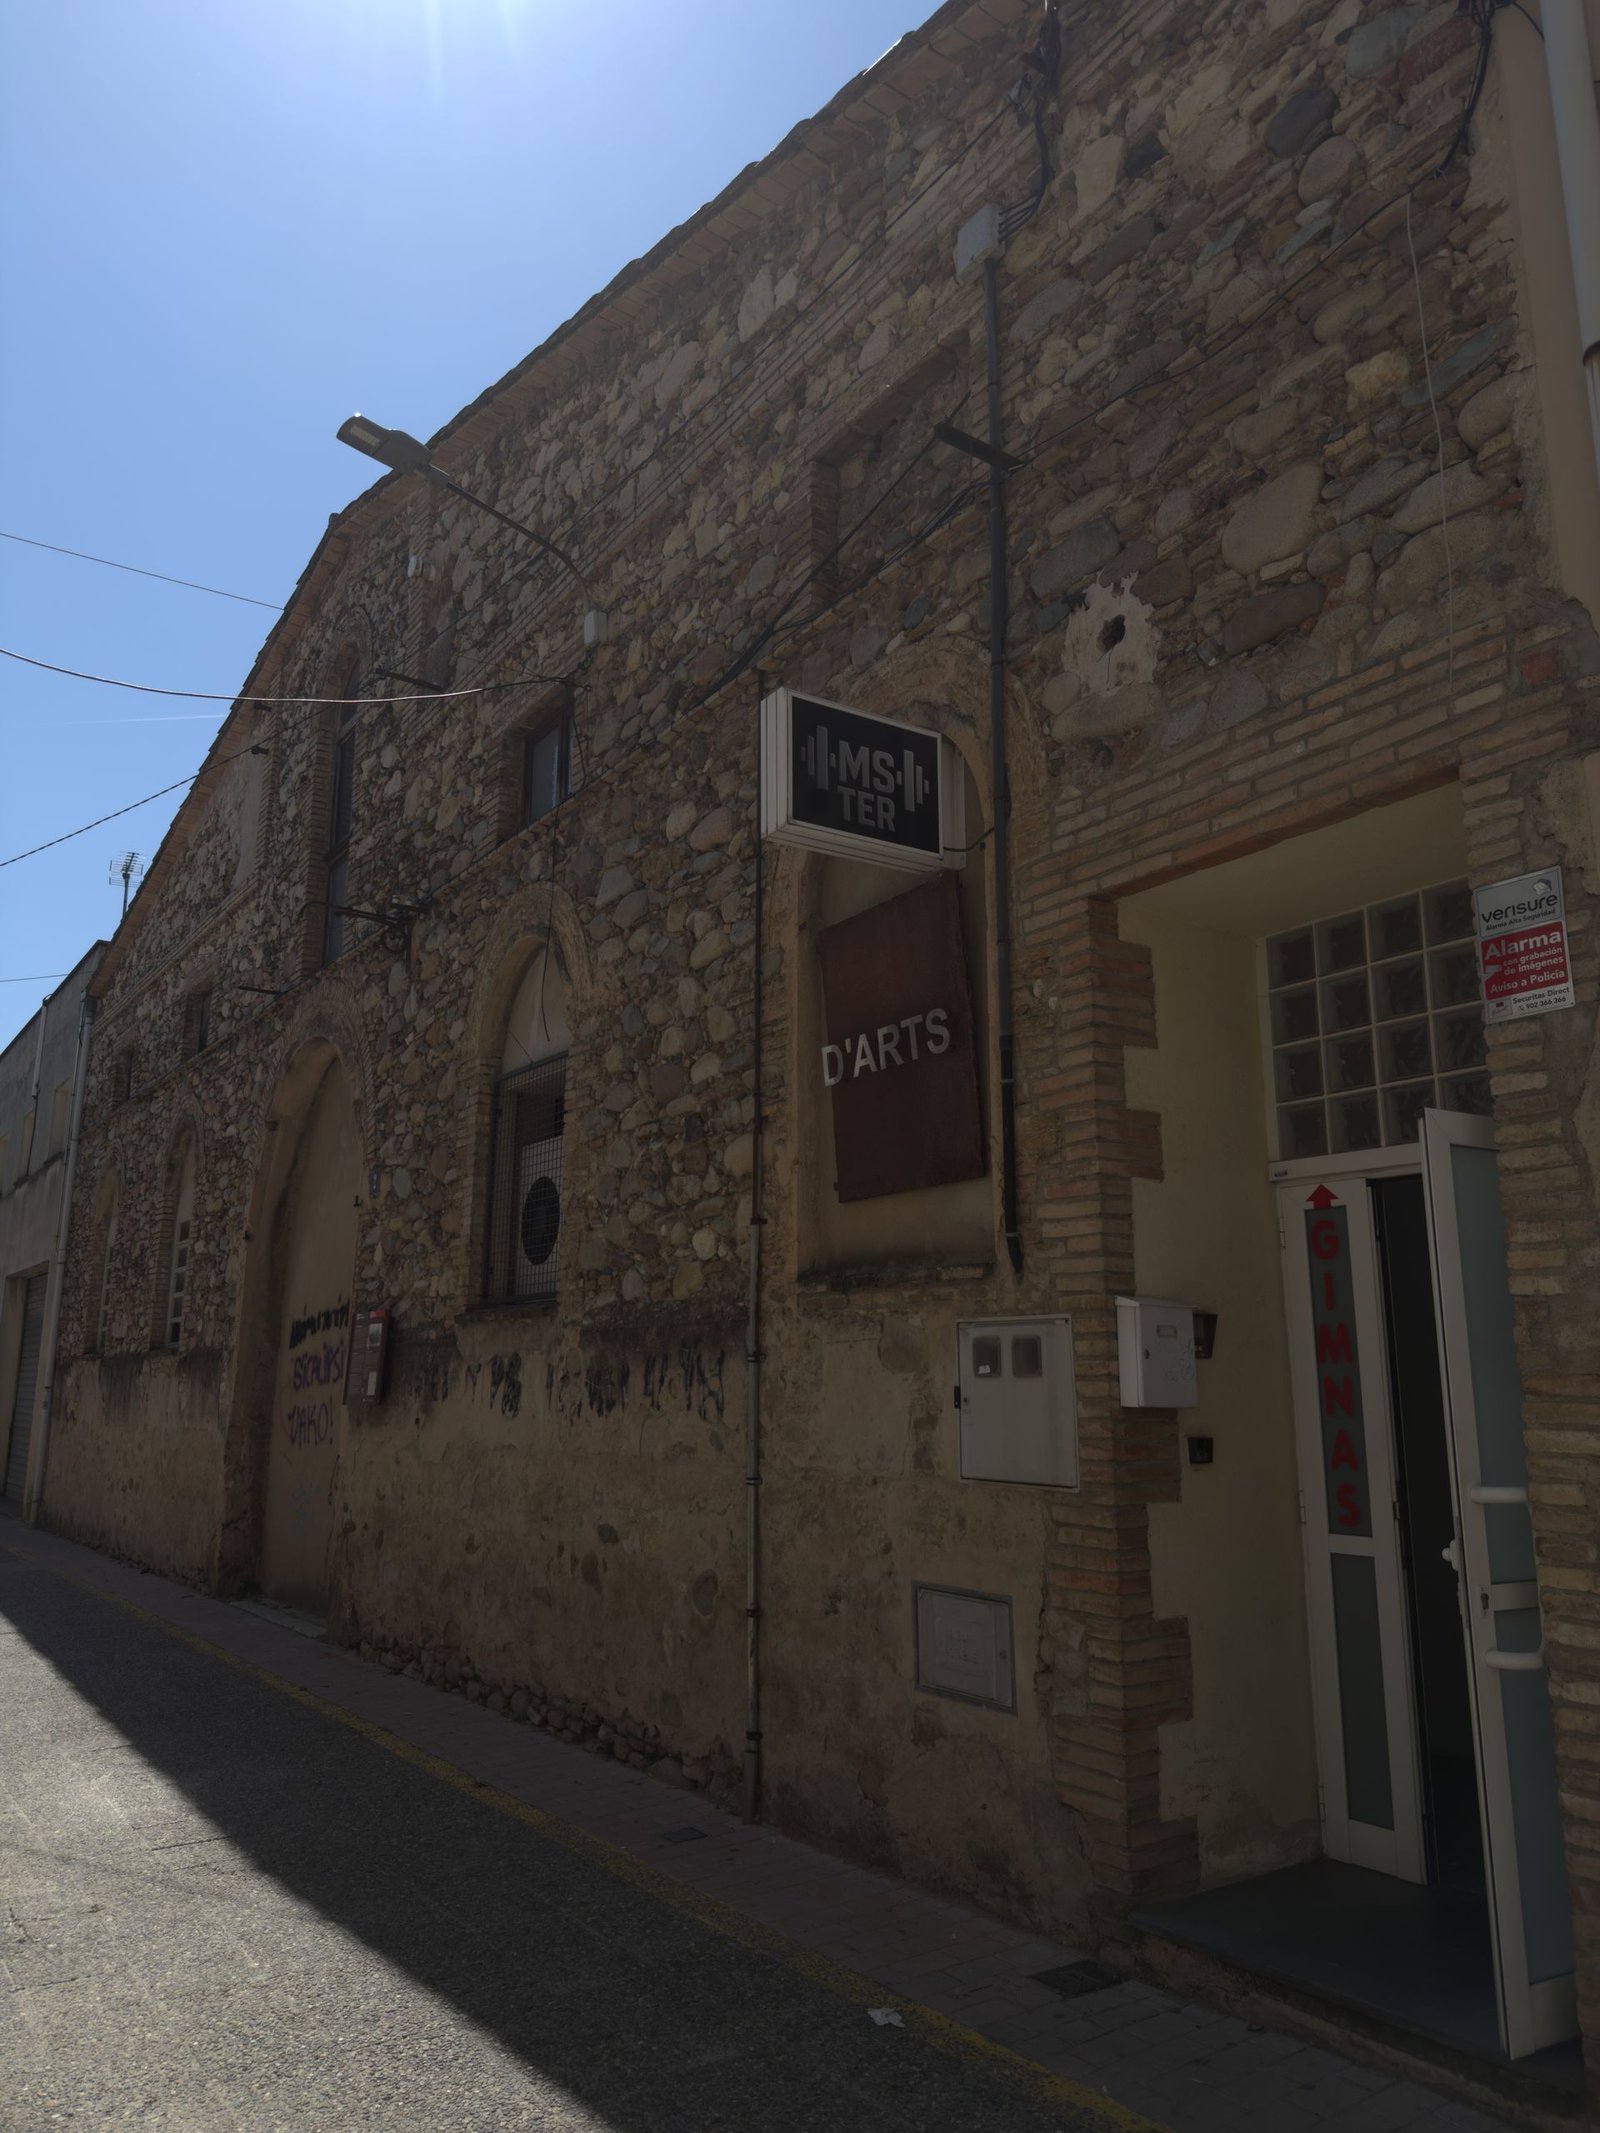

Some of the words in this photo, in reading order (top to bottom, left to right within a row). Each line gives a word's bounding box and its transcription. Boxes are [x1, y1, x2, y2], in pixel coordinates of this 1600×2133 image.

[838, 739, 895, 794] MS
[837, 784, 896, 833] TER
[1481, 894, 1558, 923] verisure
[1509, 917, 1522, 925] Alta
[1522, 908, 1556, 921] Seguridad
[1485, 931, 1562, 960] Alarma
[1503, 957, 1518, 966] con
[1520, 946, 1562, 964] grabación
[1504, 966, 1516, 976] de
[1518, 956, 1564, 973] imágenes
[1490, 980, 1518, 994] Aviso
[1520, 978, 1528, 986] a
[1530, 969, 1565, 985] Policía
[1513, 991, 1545, 1004] Securitas
[1547, 986, 1570, 997] Direct
[821, 1007, 951, 1087] D'ARTS
[1310, 1219, 1361, 1528] GIMNAS
